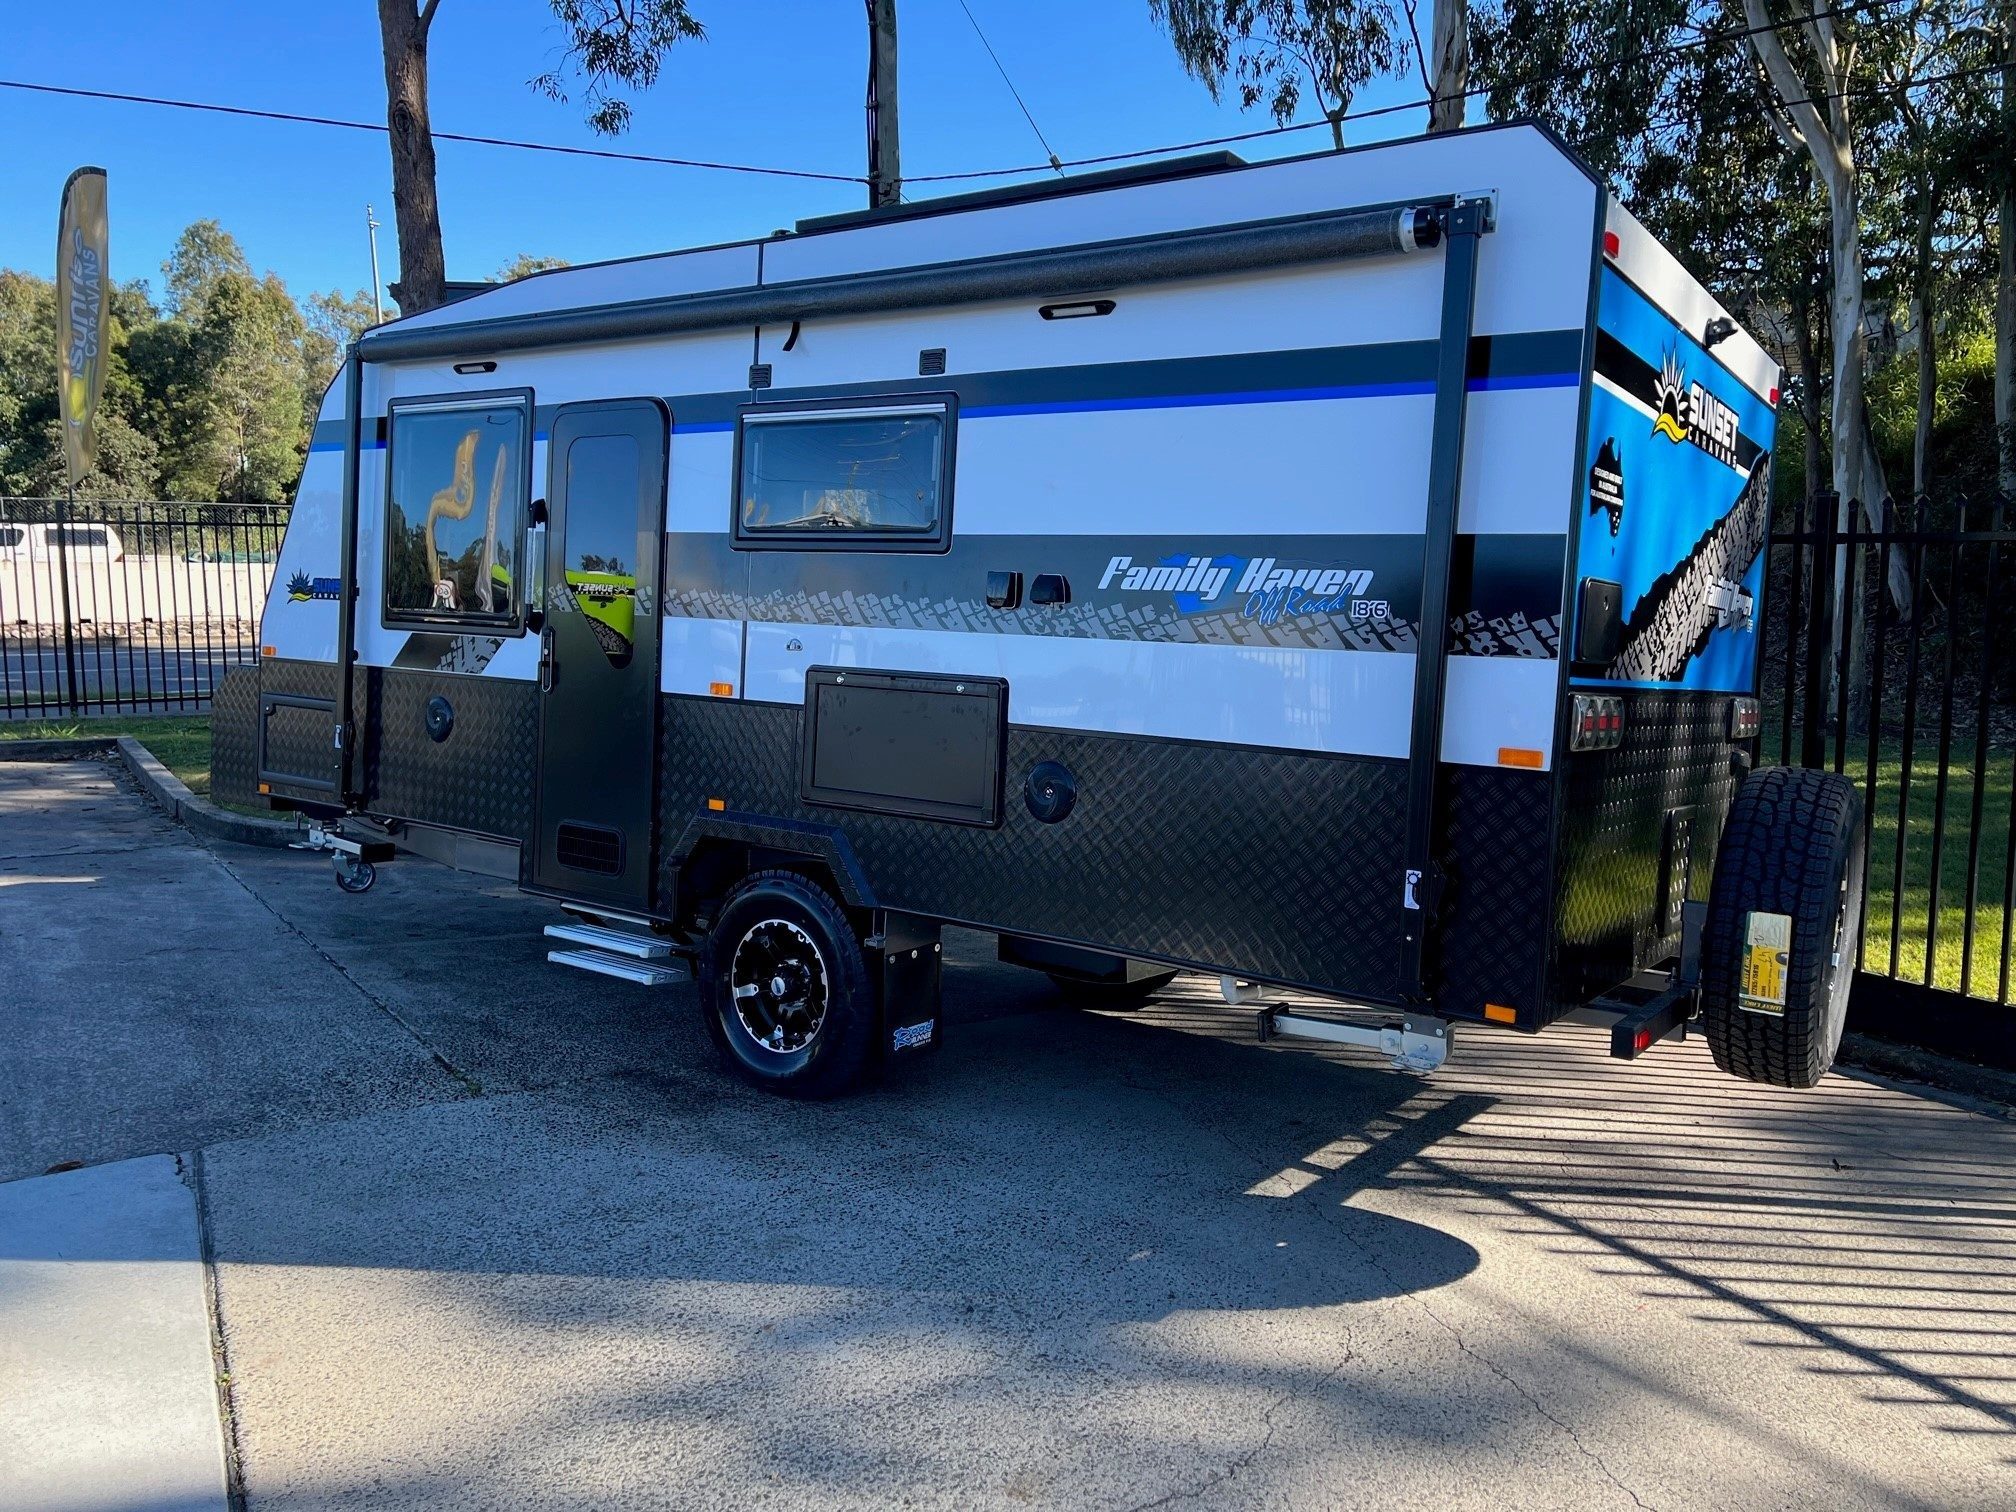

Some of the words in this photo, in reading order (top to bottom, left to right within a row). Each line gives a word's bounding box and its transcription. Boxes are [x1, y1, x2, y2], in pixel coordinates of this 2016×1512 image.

[82, 248, 100, 358] CARAVANS
[1688, 382, 1739, 452] SUNSET
[1687, 425, 1737, 469] CARAVANS
[313, 578, 341, 593] SUNS
[1097, 556, 1232, 601] Family
[1235, 557, 1374, 596] Haven
[1244, 586, 1286, 626] Off
[1283, 583, 1353, 617] Road
